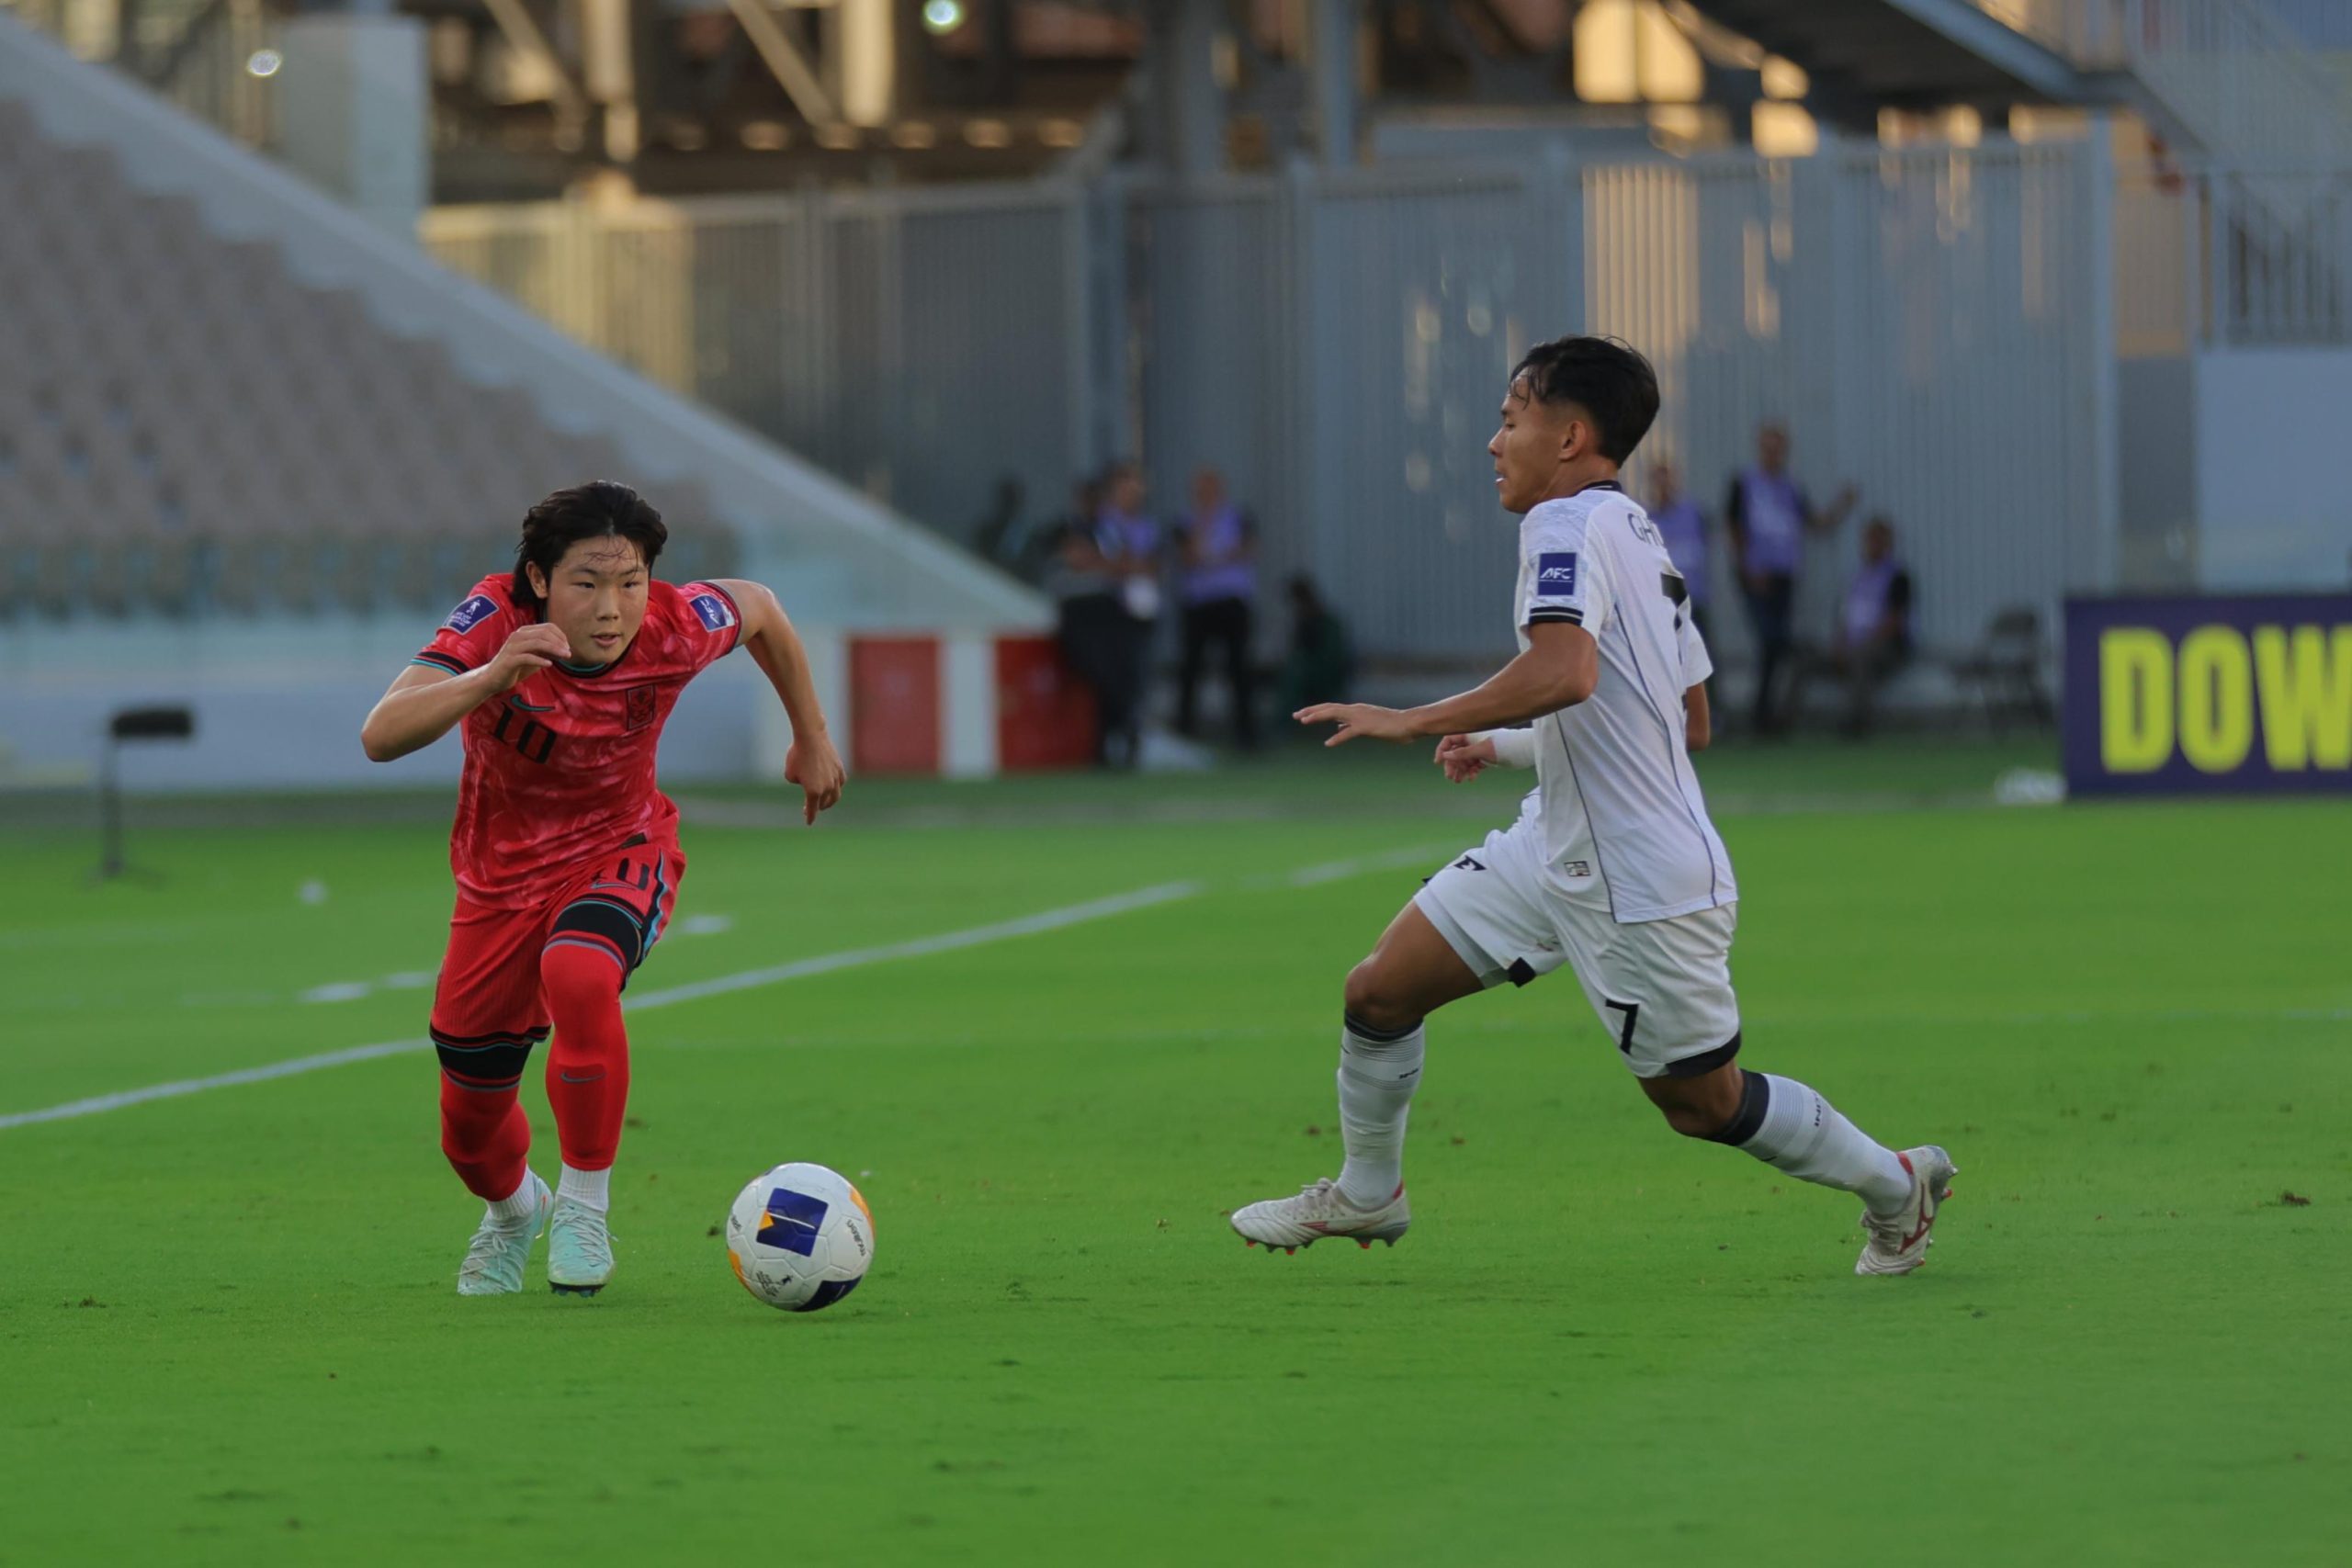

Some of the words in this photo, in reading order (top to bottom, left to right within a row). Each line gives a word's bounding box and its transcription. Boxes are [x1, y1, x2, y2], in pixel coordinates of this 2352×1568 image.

[1540, 567, 1573, 580] AFC
[699, 598, 720, 626] AFC
[2098, 624, 2352, 774] DOW
[489, 701, 559, 764] 10
[1605, 998, 1640, 1055] 7
